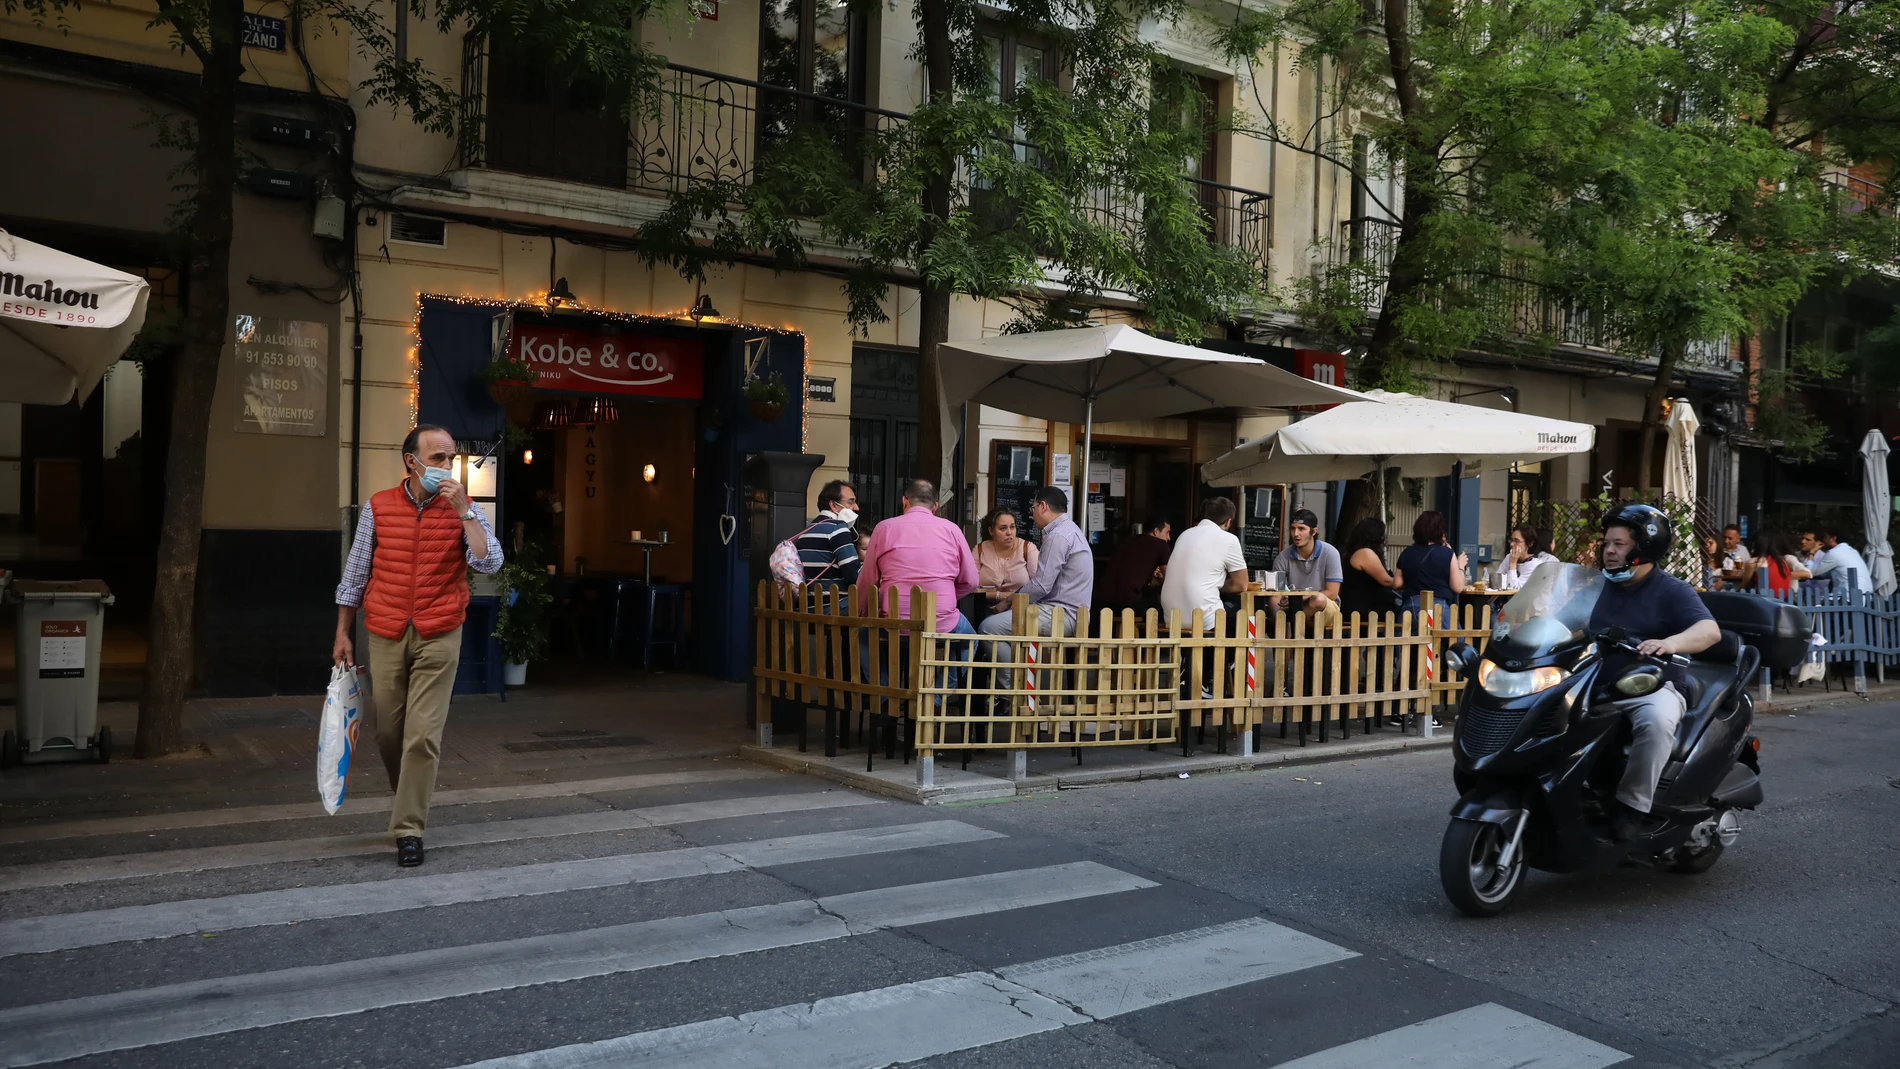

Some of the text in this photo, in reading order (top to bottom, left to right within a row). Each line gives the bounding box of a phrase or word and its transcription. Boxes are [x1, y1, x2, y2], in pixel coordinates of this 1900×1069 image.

[242, 15, 280, 30] ALLE
[241, 30, 278, 49] ZANO
[0, 271, 99, 309] Mahou
[3, 302, 96, 324] ESDE 1890
[249, 333, 317, 348] EN ALQUILER
[246, 350, 317, 369] 91 553 90 90
[520, 336, 664, 373] Kobe & co.
[262, 378, 298, 391] PISOS
[277, 394, 283, 404] Y
[243, 405, 314, 419] APARTAMENTOS
[1537, 432, 1577, 444] Mahou
[584, 424, 597, 498] WAGYU
